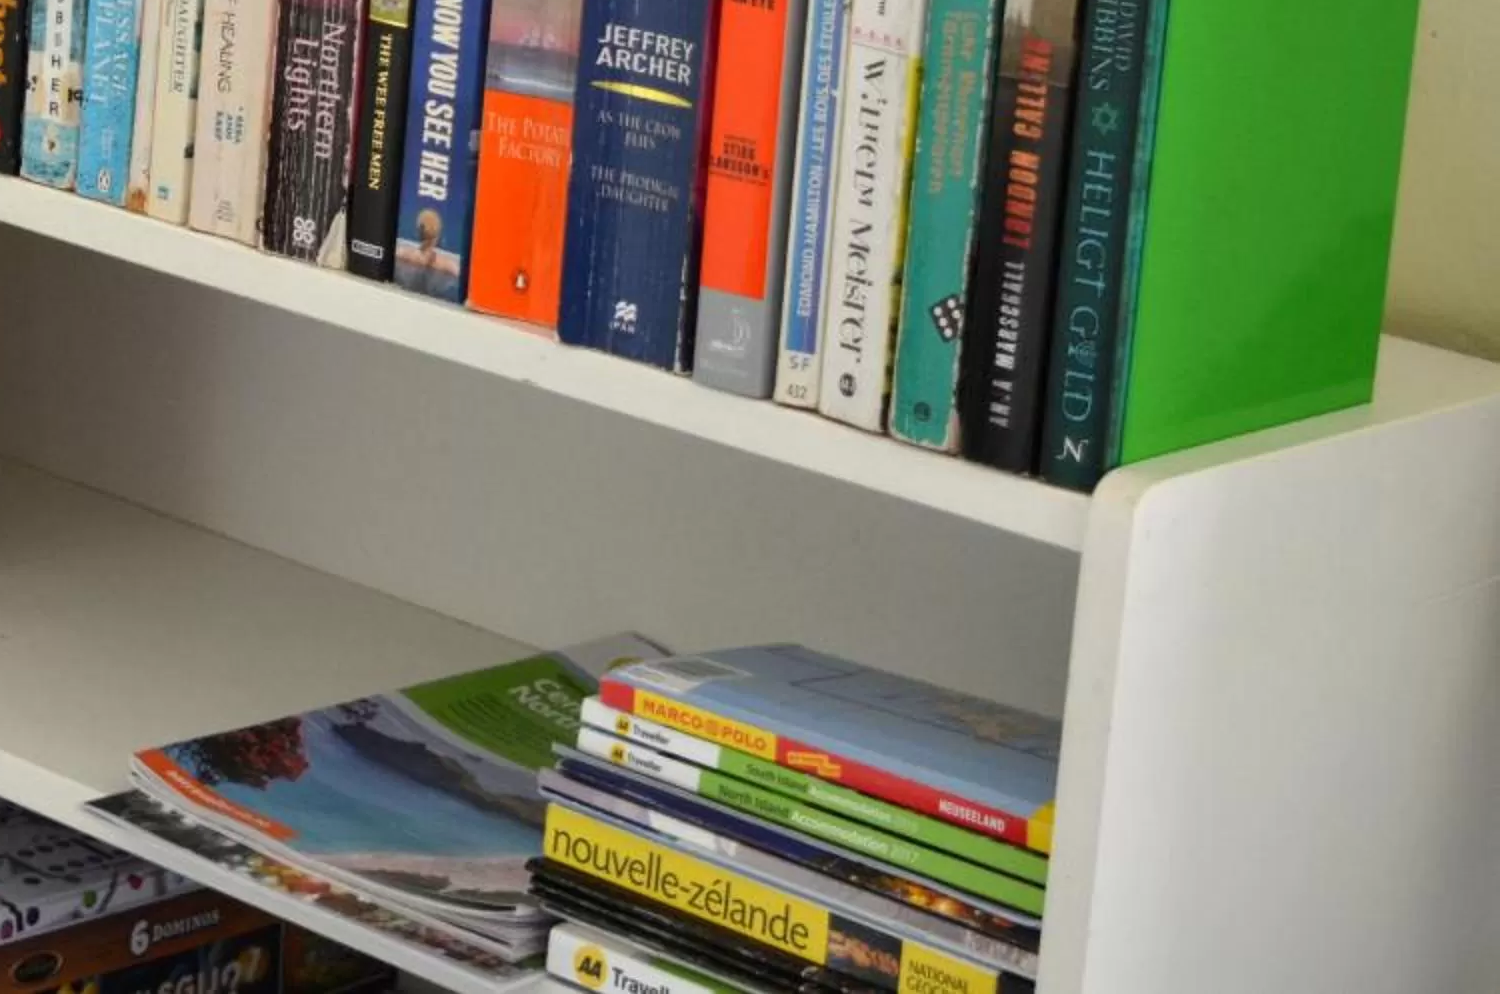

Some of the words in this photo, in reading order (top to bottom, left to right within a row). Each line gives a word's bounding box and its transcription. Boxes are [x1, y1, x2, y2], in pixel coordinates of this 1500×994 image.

[88, 0, 114, 105] PLANET
[217, 10, 238, 95] HEALING
[379, 33, 393, 67] THE
[596, 23, 695, 61] JEFFREY
[1113, 1, 1139, 73] DAVID
[282, 37, 319, 133] Lights
[314, 20, 348, 160] Northern
[375, 70, 389, 107] WEE
[427, 51, 461, 106] YOU
[595, 46, 692, 87] ARCHER
[1013, 35, 1052, 143] CALLING
[371, 108, 386, 150] FREE
[421, 97, 454, 151] SEE
[617, 113, 641, 132] THE
[644, 119, 682, 142] CROW
[367, 151, 382, 191] MEN
[417, 152, 449, 203] HER
[591, 165, 616, 186] THE
[596, 184, 669, 212] DAUGHTER
[1003, 149, 1041, 250] LONDON
[1074, 149, 1117, 299] HELIGT
[995, 261, 1026, 370] MARSCHALL
[641, 696, 705, 730] MARCO
[720, 725, 768, 753] POLO
[718, 783, 752, 804] North
[745, 762, 778, 782] South
[938, 798, 1006, 834] NEUSEELAND
[550, 823, 810, 951] nouvelle-zélande
[129, 919, 150, 956] 6
[152, 909, 221, 943] DOMINOS
[577, 956, 604, 981] AA
[908, 957, 971, 994] NATIONAL
